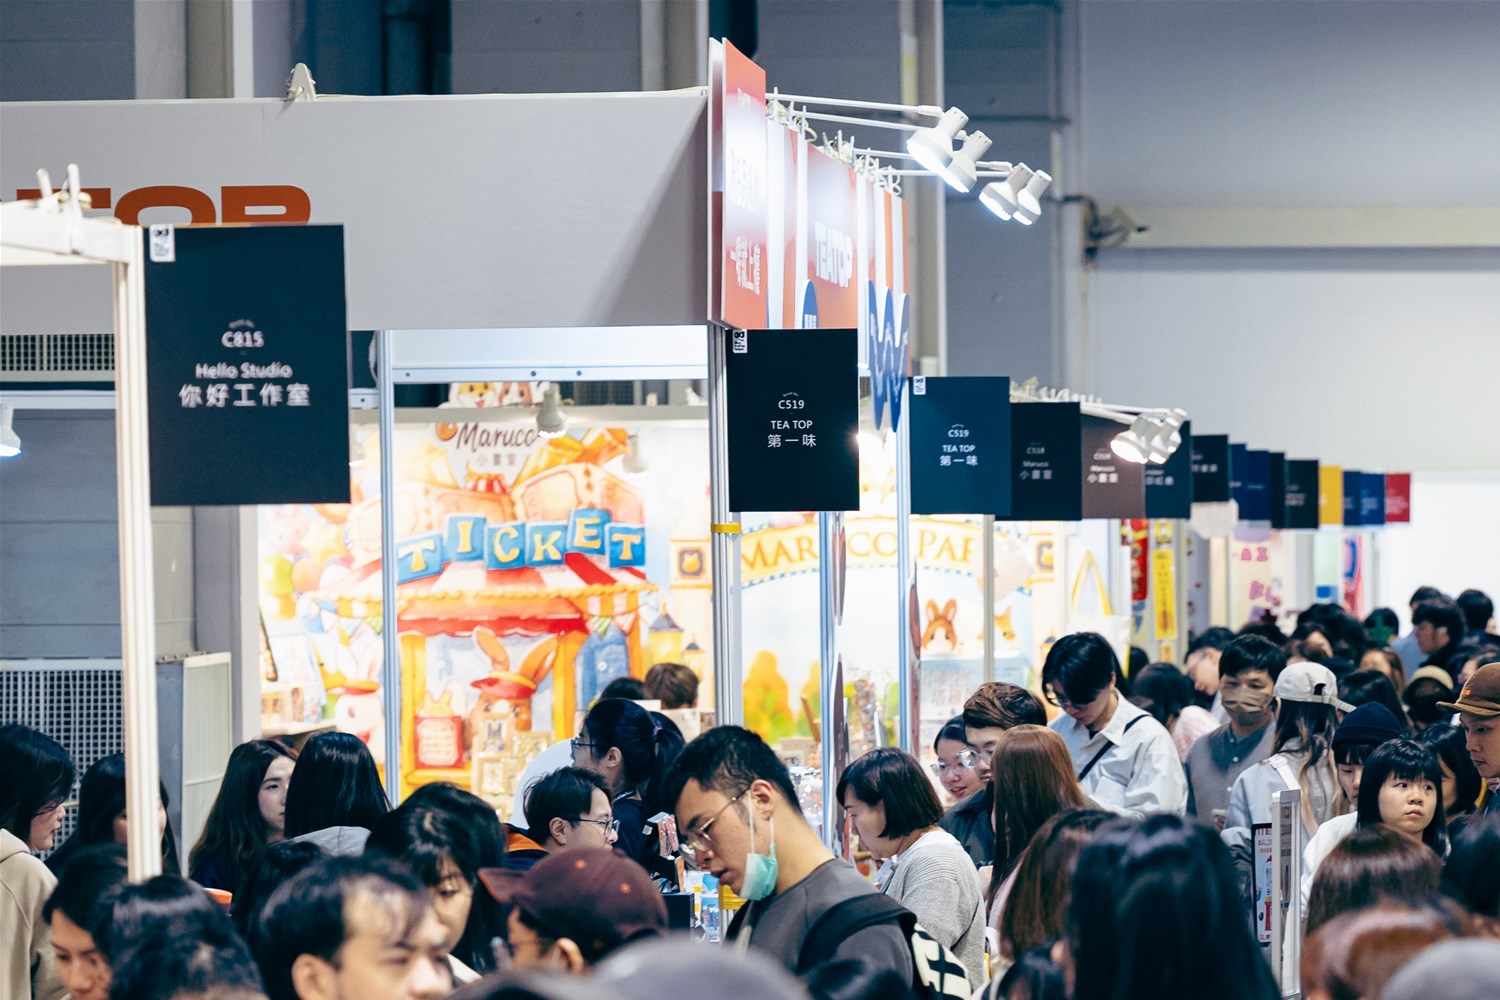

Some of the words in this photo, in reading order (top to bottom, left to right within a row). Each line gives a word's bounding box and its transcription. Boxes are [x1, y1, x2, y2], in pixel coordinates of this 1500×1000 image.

[221, 330, 265, 348] C815
[195, 361, 239, 379] Hello
[240, 361, 293, 379] Studio
[179, 382, 311, 408] 你好工作室
[778, 399, 805, 409] C519
[770, 420, 790, 430] TEA
[792, 420, 813, 430] TOP
[767, 433, 817, 448] 第一味
[947, 429, 970, 438] C519
[942, 444, 958, 453] TEA
[959, 444, 976, 453] TOP
[939, 455, 978, 467] 第一味
[397, 517, 642, 573] TICKET
[741, 531, 898, 569] MARCO
